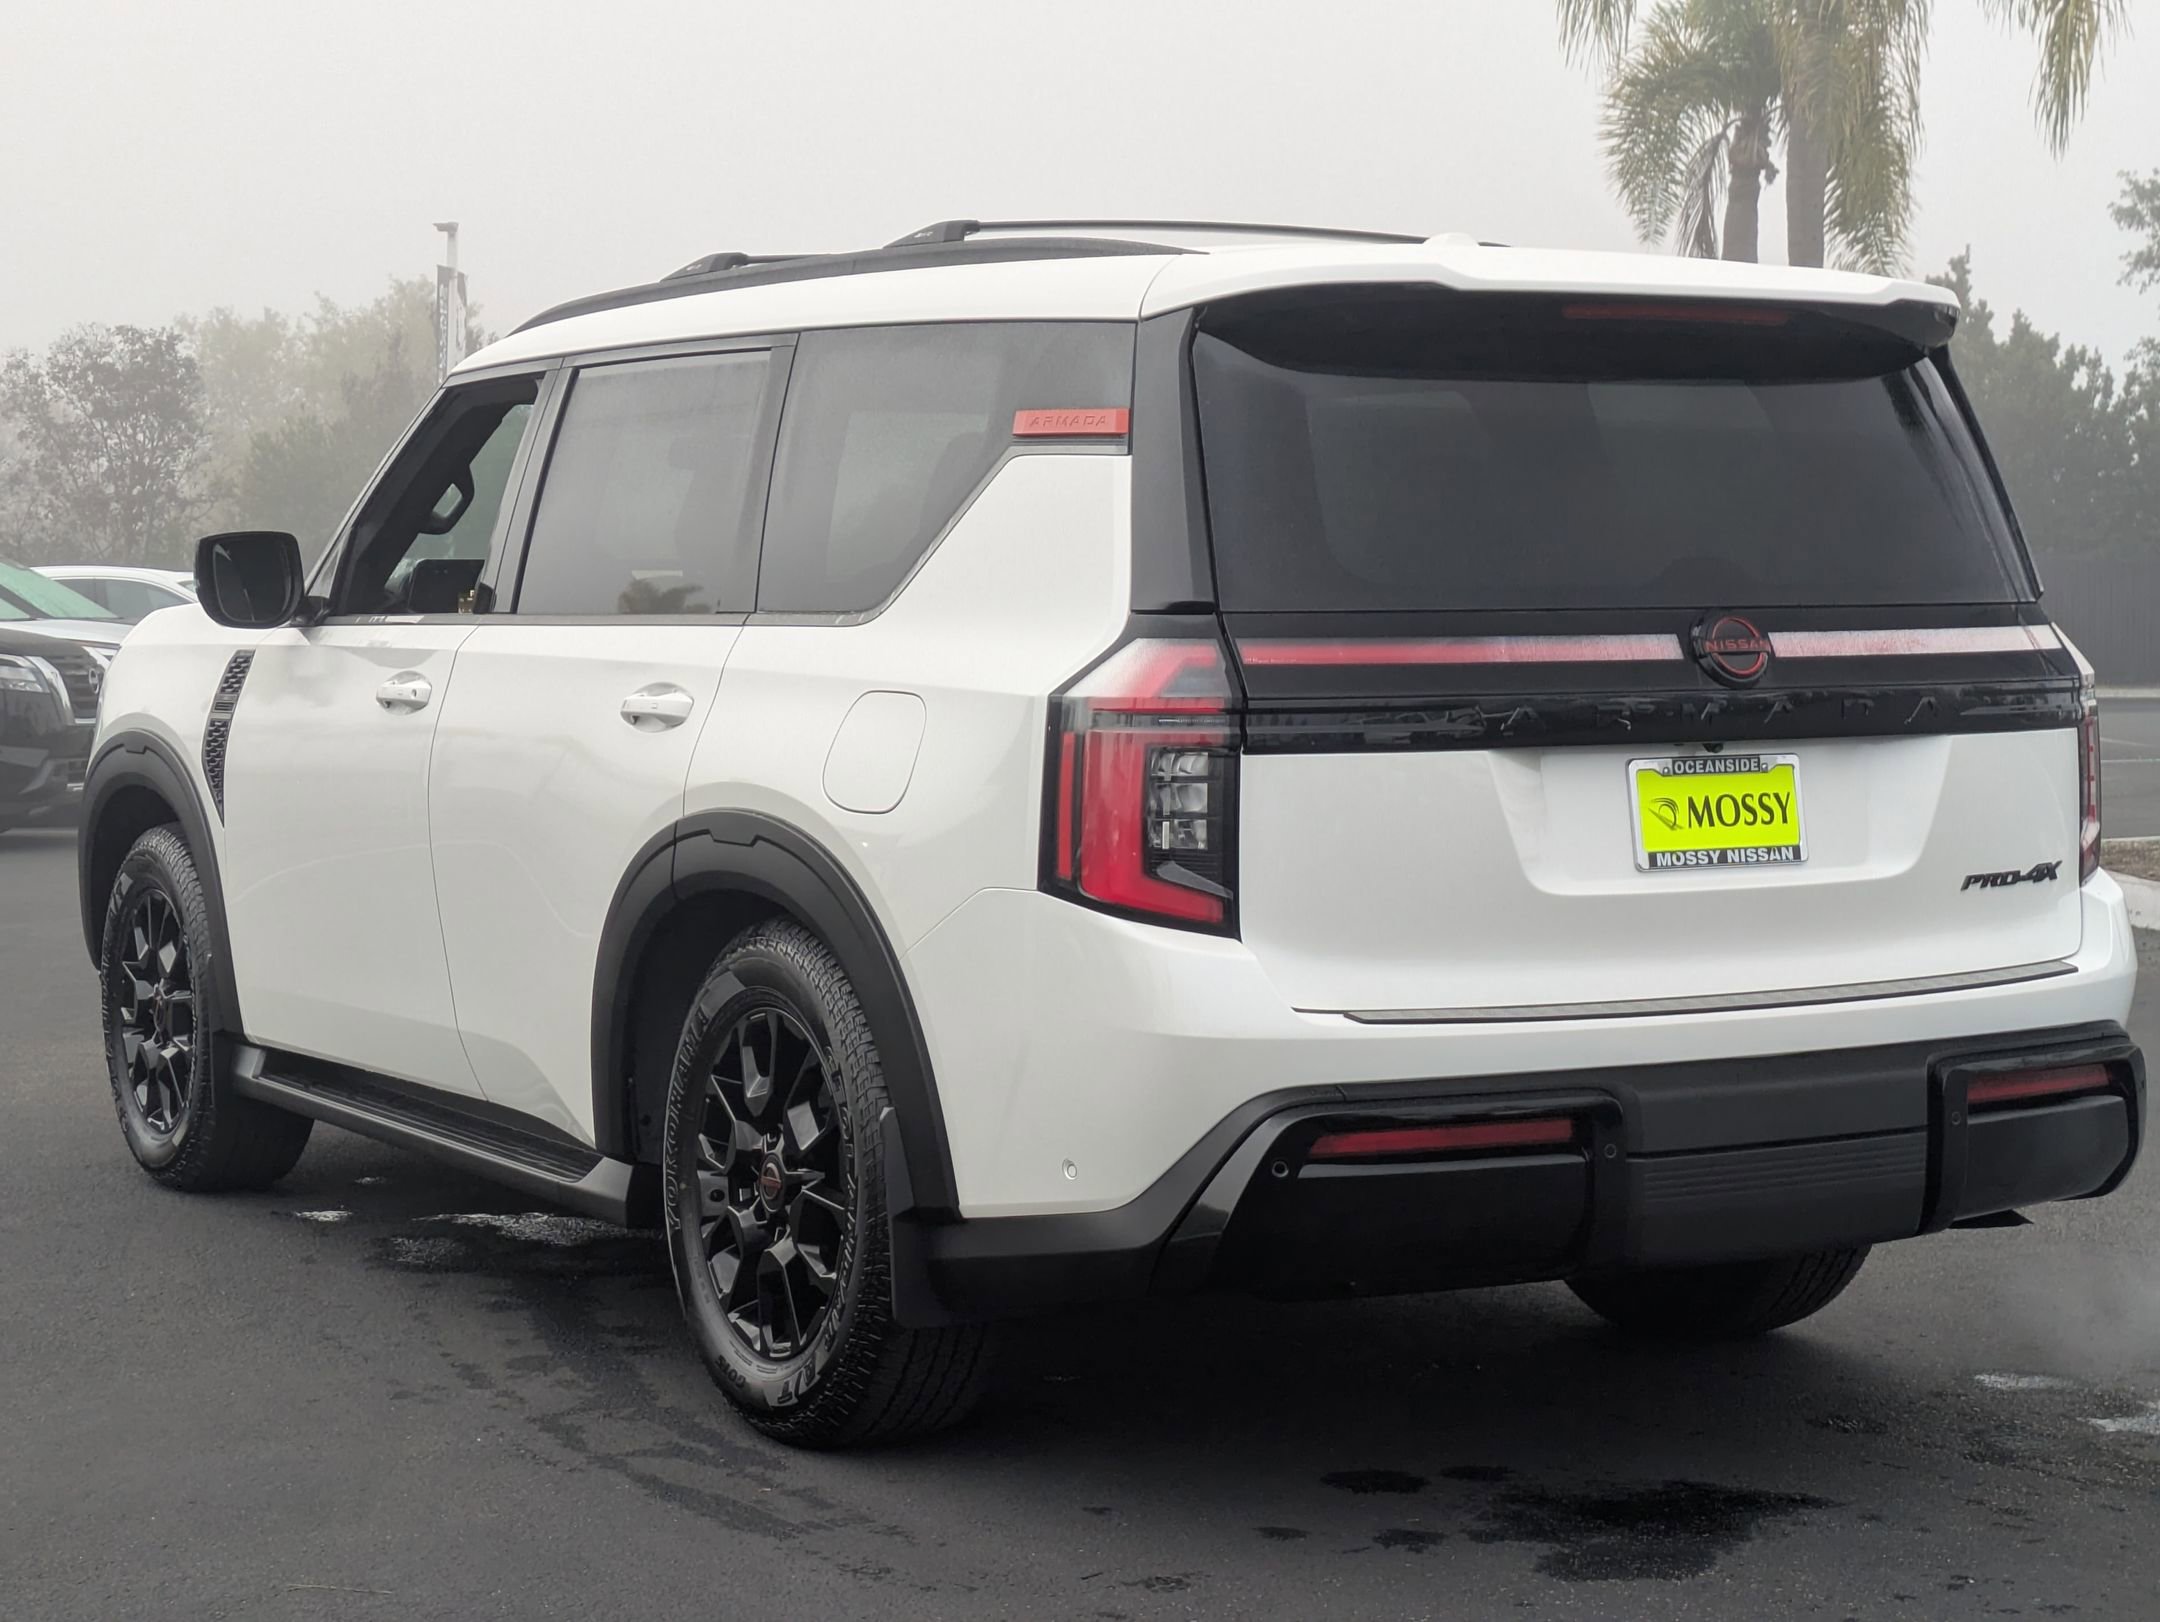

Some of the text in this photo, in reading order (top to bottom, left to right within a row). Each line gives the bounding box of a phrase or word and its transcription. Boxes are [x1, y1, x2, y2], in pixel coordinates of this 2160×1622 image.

[1704, 637, 1772, 653] NISSAN
[1674, 758, 1759, 774] OCEANSIDE
[1687, 792, 1790, 829] MOSSY
[1656, 847, 1793, 867] MOSSY NISSAN
[1960, 860, 2063, 891] PRO-4X
